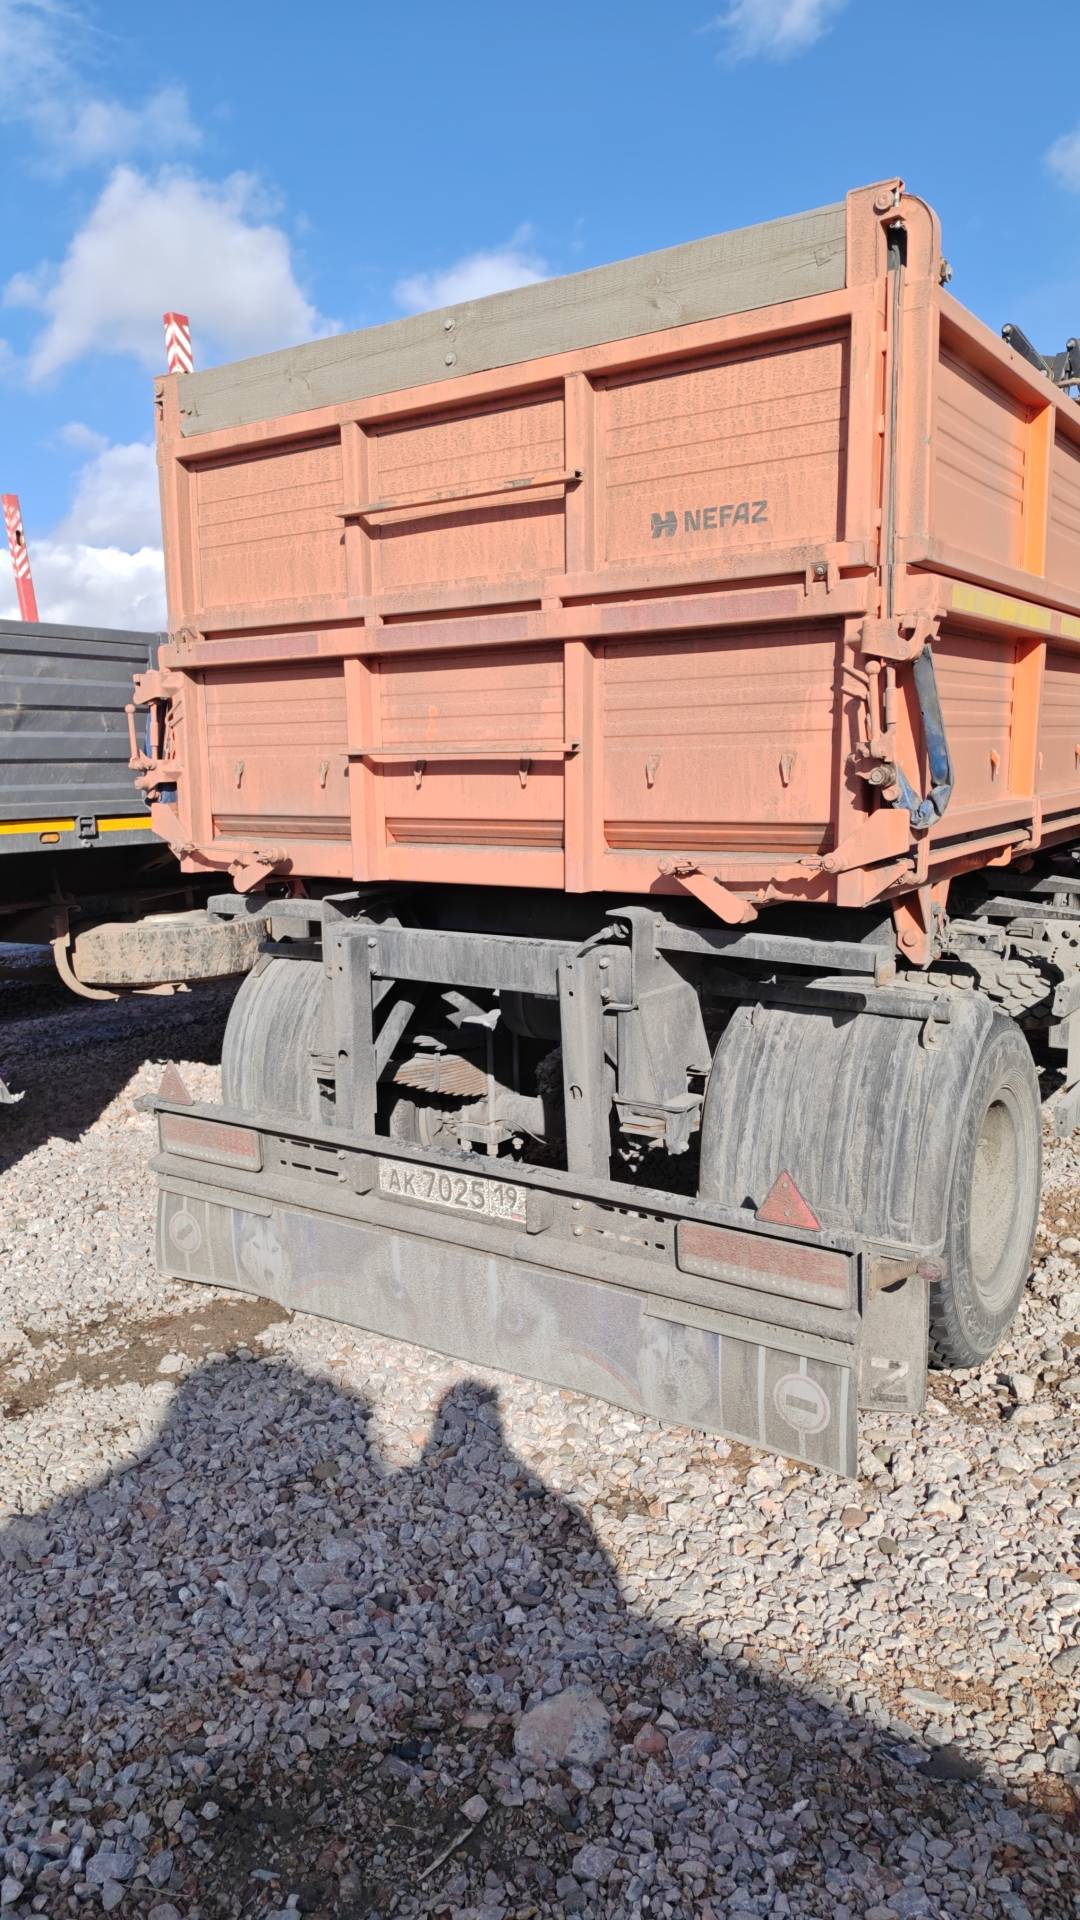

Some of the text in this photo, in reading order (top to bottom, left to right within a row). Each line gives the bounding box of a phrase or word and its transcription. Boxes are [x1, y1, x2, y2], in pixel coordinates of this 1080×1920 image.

[684, 500, 768, 532] NEFAZ
[389, 1168, 518, 1209] AK 7025 19
